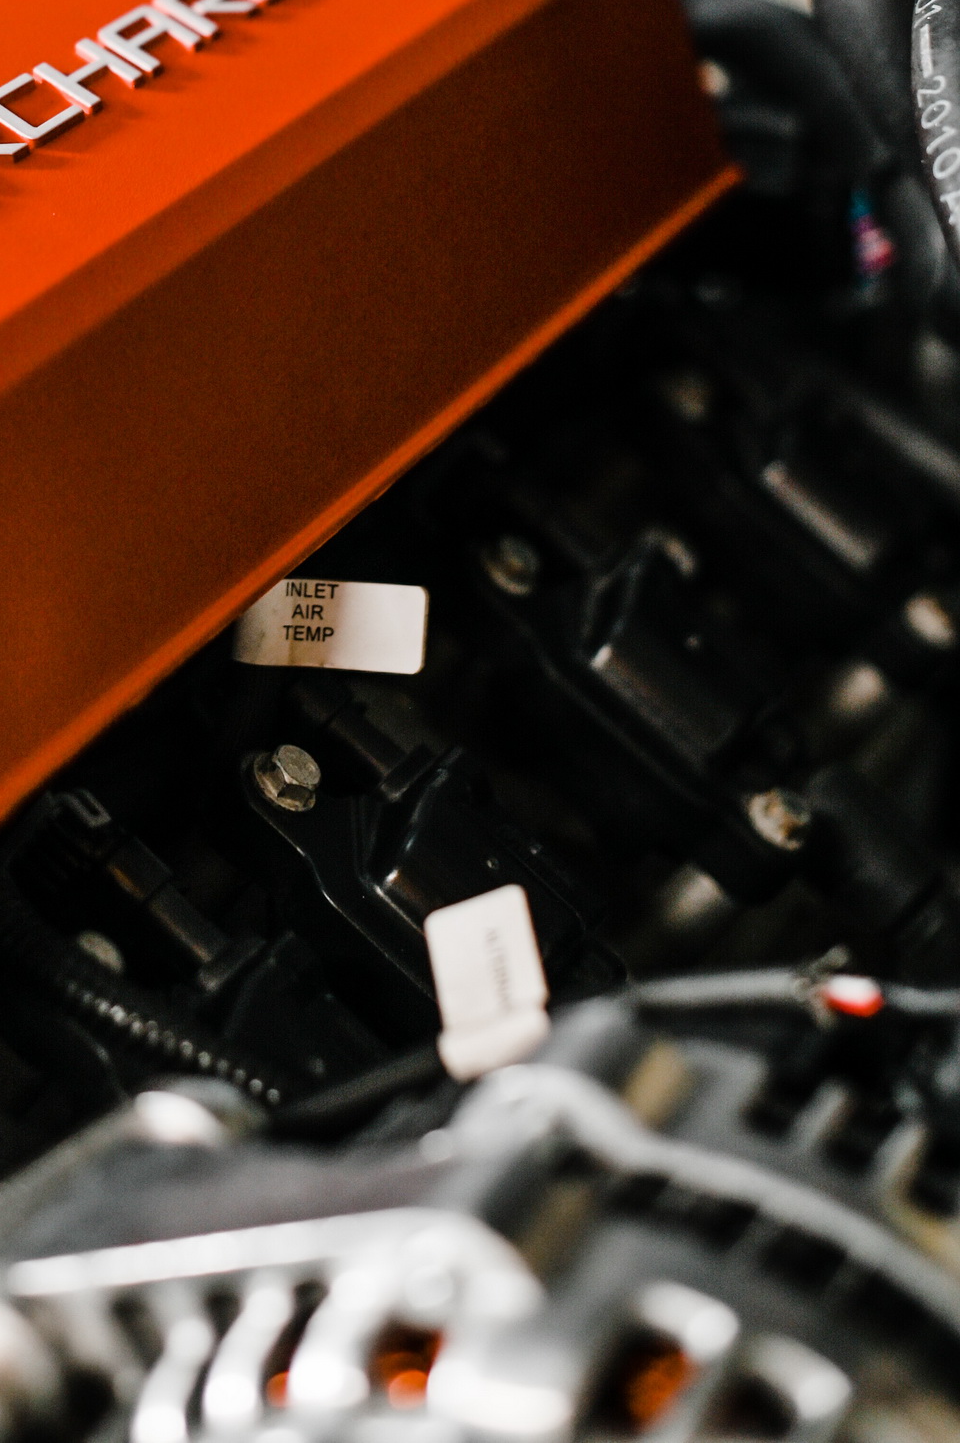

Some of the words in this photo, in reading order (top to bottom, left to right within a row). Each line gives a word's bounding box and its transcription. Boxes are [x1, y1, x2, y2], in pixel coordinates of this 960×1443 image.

[285, 581, 339, 599] INLET
[291, 604, 324, 620] AIR
[283, 625, 334, 642] TEMP
